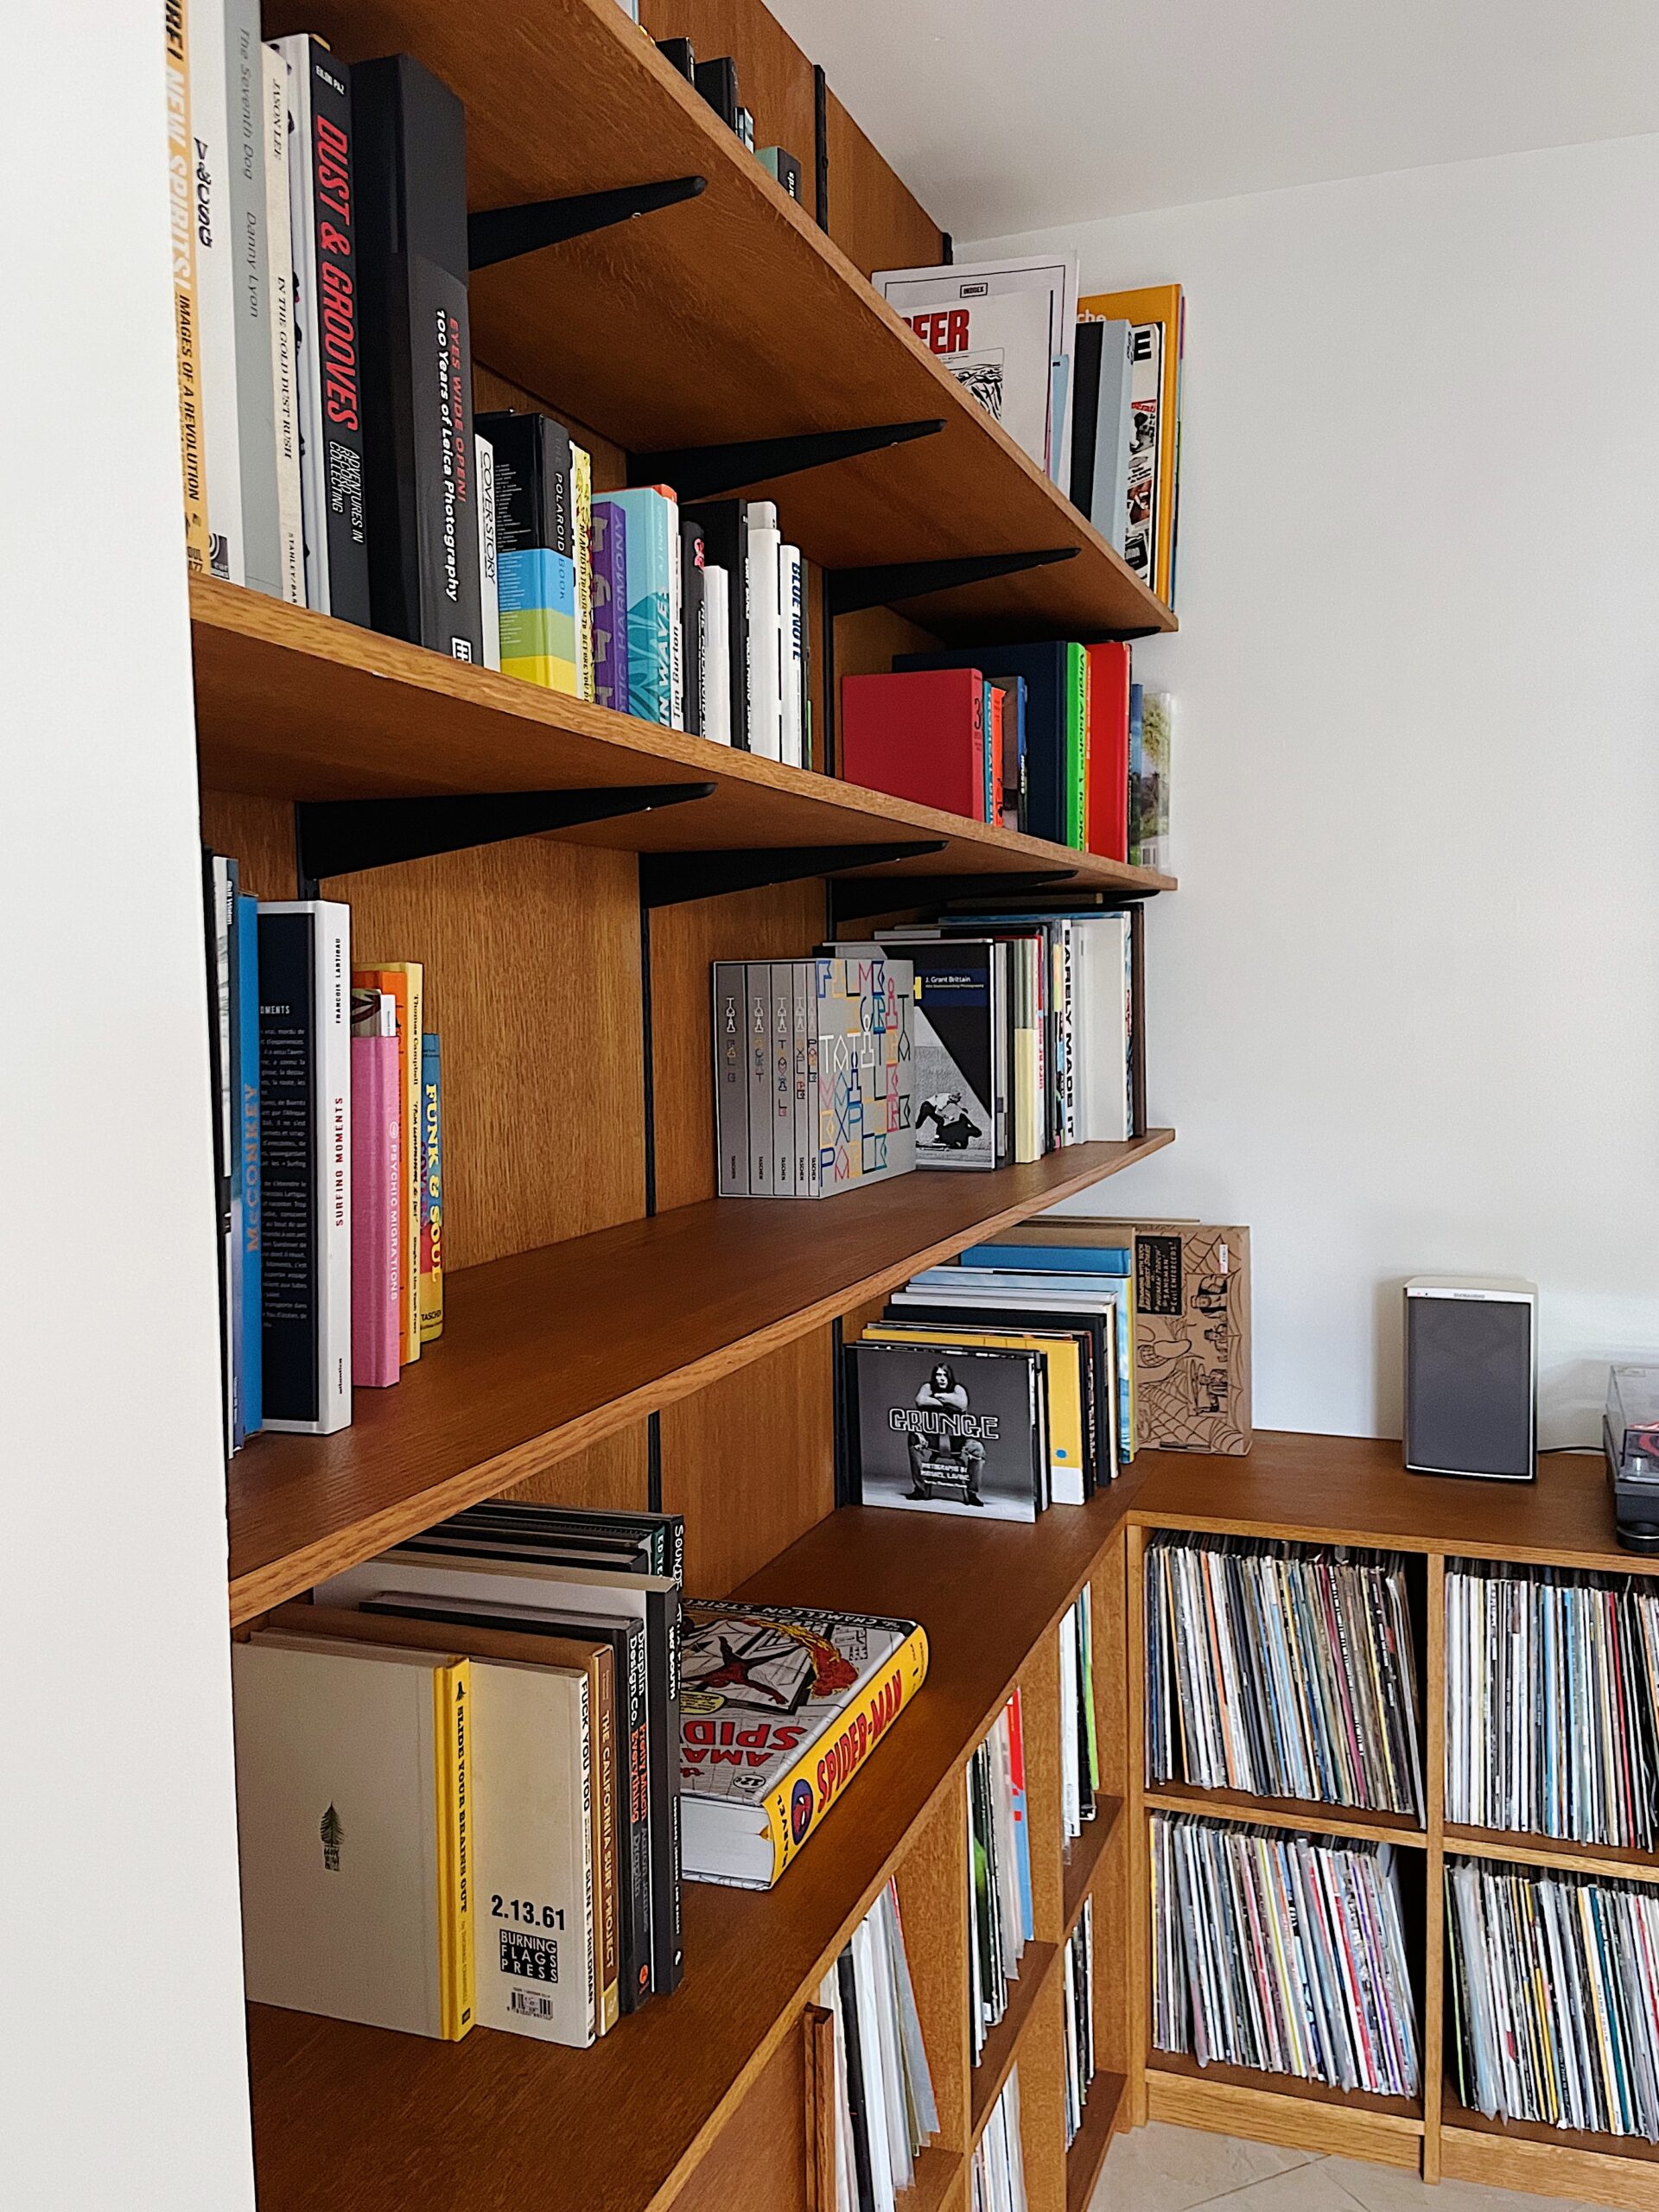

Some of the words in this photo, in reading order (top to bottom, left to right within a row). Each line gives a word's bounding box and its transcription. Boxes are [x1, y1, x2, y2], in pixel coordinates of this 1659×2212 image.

[241, 63, 253, 138] Seventh
[242, 143, 255, 181] Dog
[315, 115, 350, 226] DUST
[786, 171, 795, 198] ards
[245, 212, 257, 270] Danny
[320, 221, 351, 256] &
[247, 274, 260, 318] Lyon
[179, 294, 192, 356] IMAGES
[320, 261, 359, 431] GROOVES
[435, 310, 448, 347] 100
[449, 317, 460, 368] EYES
[902, 309, 969, 355] FER
[181, 361, 194, 383] OF
[280, 331, 289, 374] GOLD
[437, 350, 449, 400] Years
[184, 385, 195, 397] A
[281, 377, 291, 417] DUST
[441, 403, 453, 425] of
[451, 375, 464, 433] WIDE
[184, 401, 200, 501] REVOLUTION
[283, 420, 293, 459] RUSH
[442, 427, 454, 475] Leica
[329, 441, 344, 513] COLLECTING
[348, 449, 363, 528] ADVENTURES
[454, 436, 467, 502] OPEN!
[352, 529, 363, 543] IN
[556, 473, 566, 551] POLAROID
[442, 479, 461, 601] Photography
[289, 532, 297, 604] STANLEY/BAR
[557, 558, 567, 601] BOOK
[614, 514, 626, 652] HARMONY
[671, 626, 681, 684] Burton
[671, 690, 681, 719] Tim
[1064, 929, 1072, 1027] BARELY
[334, 1096, 344, 1163] MOMENTS
[425, 1084, 439, 1169] FUNK
[1067, 1116, 1074, 1138] IT
[334, 1170, 344, 1227] SURFING
[390, 1144, 398, 1207] PSYCHIC
[428, 1175, 442, 1198] &
[429, 1205, 443, 1283] SOUL
[888, 1408, 1000, 1440] GRUNGE
[763, 1606, 878, 1626] CHAMELEON
[628, 1637, 639, 1696] Design
[637, 1631, 646, 1696] Draplin
[581, 1681, 590, 1729] FUCK
[601, 1710, 610, 1745] THE
[630, 1697, 639, 1726] Co.
[582, 1732, 591, 1771] YOU
[639, 1722, 647, 1770] Pretty
[680, 1747, 775, 1768] AMA
[682, 1720, 809, 1751] SPID
[817, 1669, 902, 1814] SPIDER-MAN
[457, 1759, 466, 1808] YOUR
[582, 1776, 591, 1812] TOO
[602, 1747, 613, 1849] CALIFORNIA
[630, 1728, 640, 1824] Everything
[639, 1771, 648, 1821] Much
[458, 1809, 467, 1874] BRAINS
[585, 1868, 594, 1908] GLEN
[603, 1850, 613, 1891] SURF
[491, 1894, 565, 1931] 2.13.61
[586, 1910, 594, 1926] E.
[604, 1894, 614, 1969] PROJECT
[500, 1930, 557, 1954] BURNING
[501, 1944, 557, 1968] FLAGS
[501, 1958, 558, 1982] PRESS
[587, 1928, 595, 2005] FRIEDMAN
